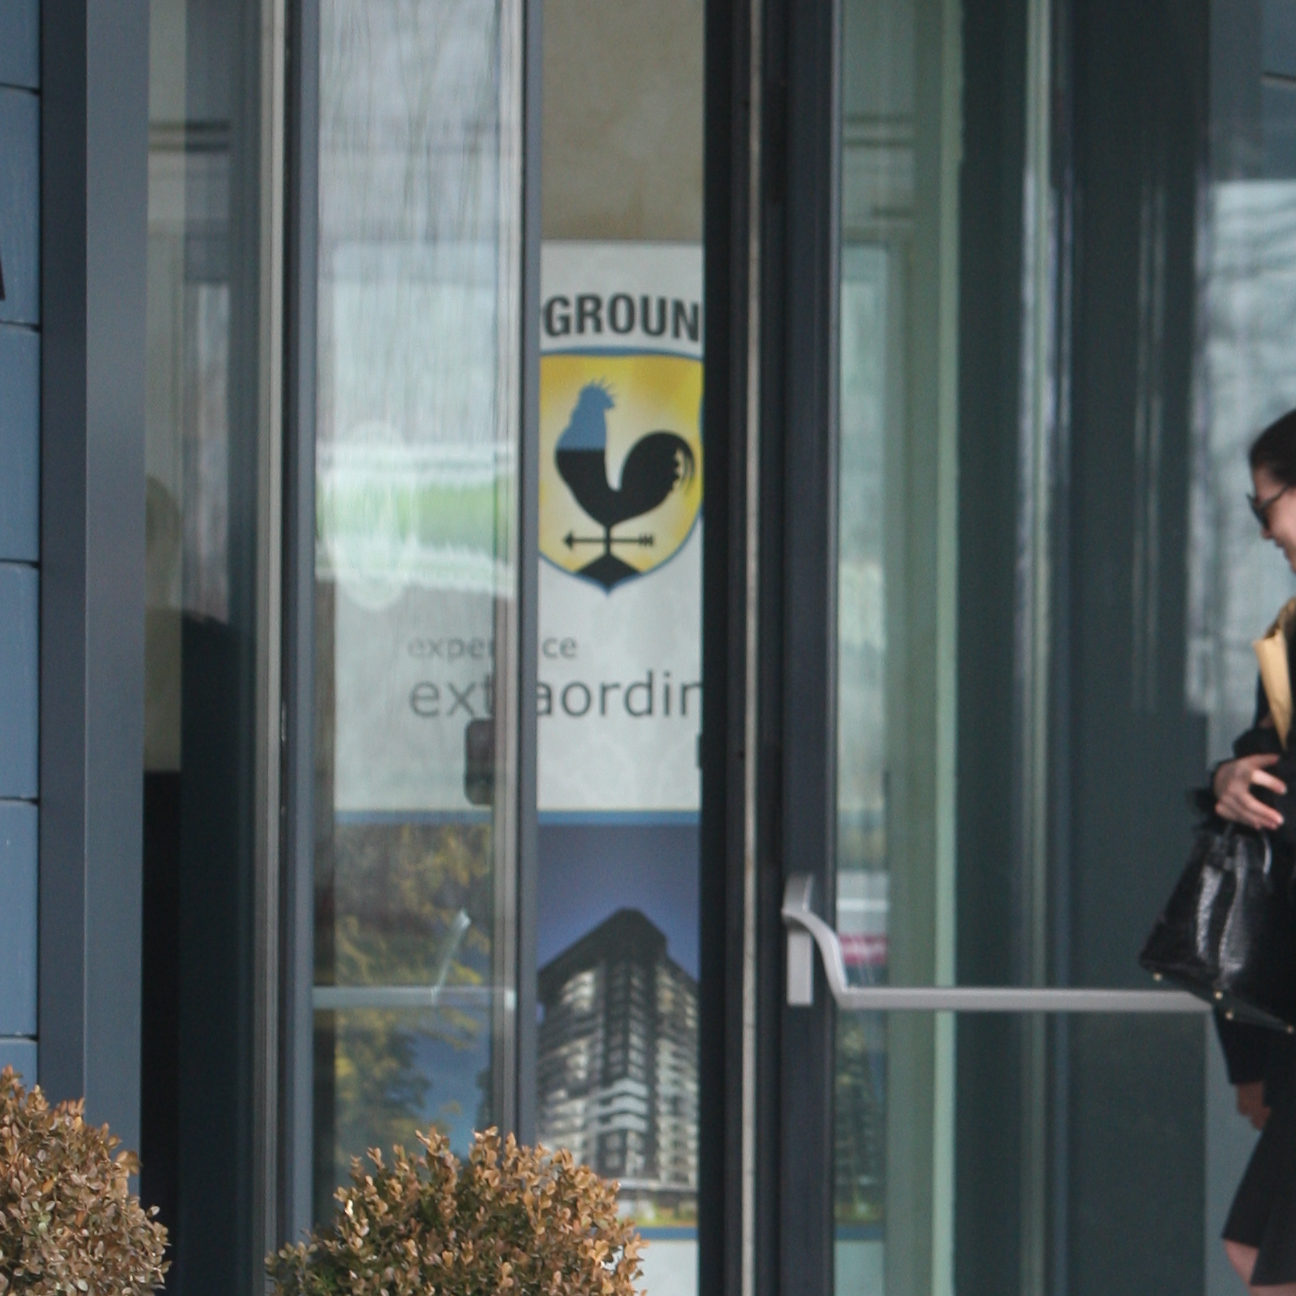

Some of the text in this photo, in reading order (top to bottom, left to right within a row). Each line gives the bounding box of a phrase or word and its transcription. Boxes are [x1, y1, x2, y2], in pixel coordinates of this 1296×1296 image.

[543, 291, 700, 342] GROUN
[408, 637, 576, 663] expece
[409, 671, 703, 717] extaordin
